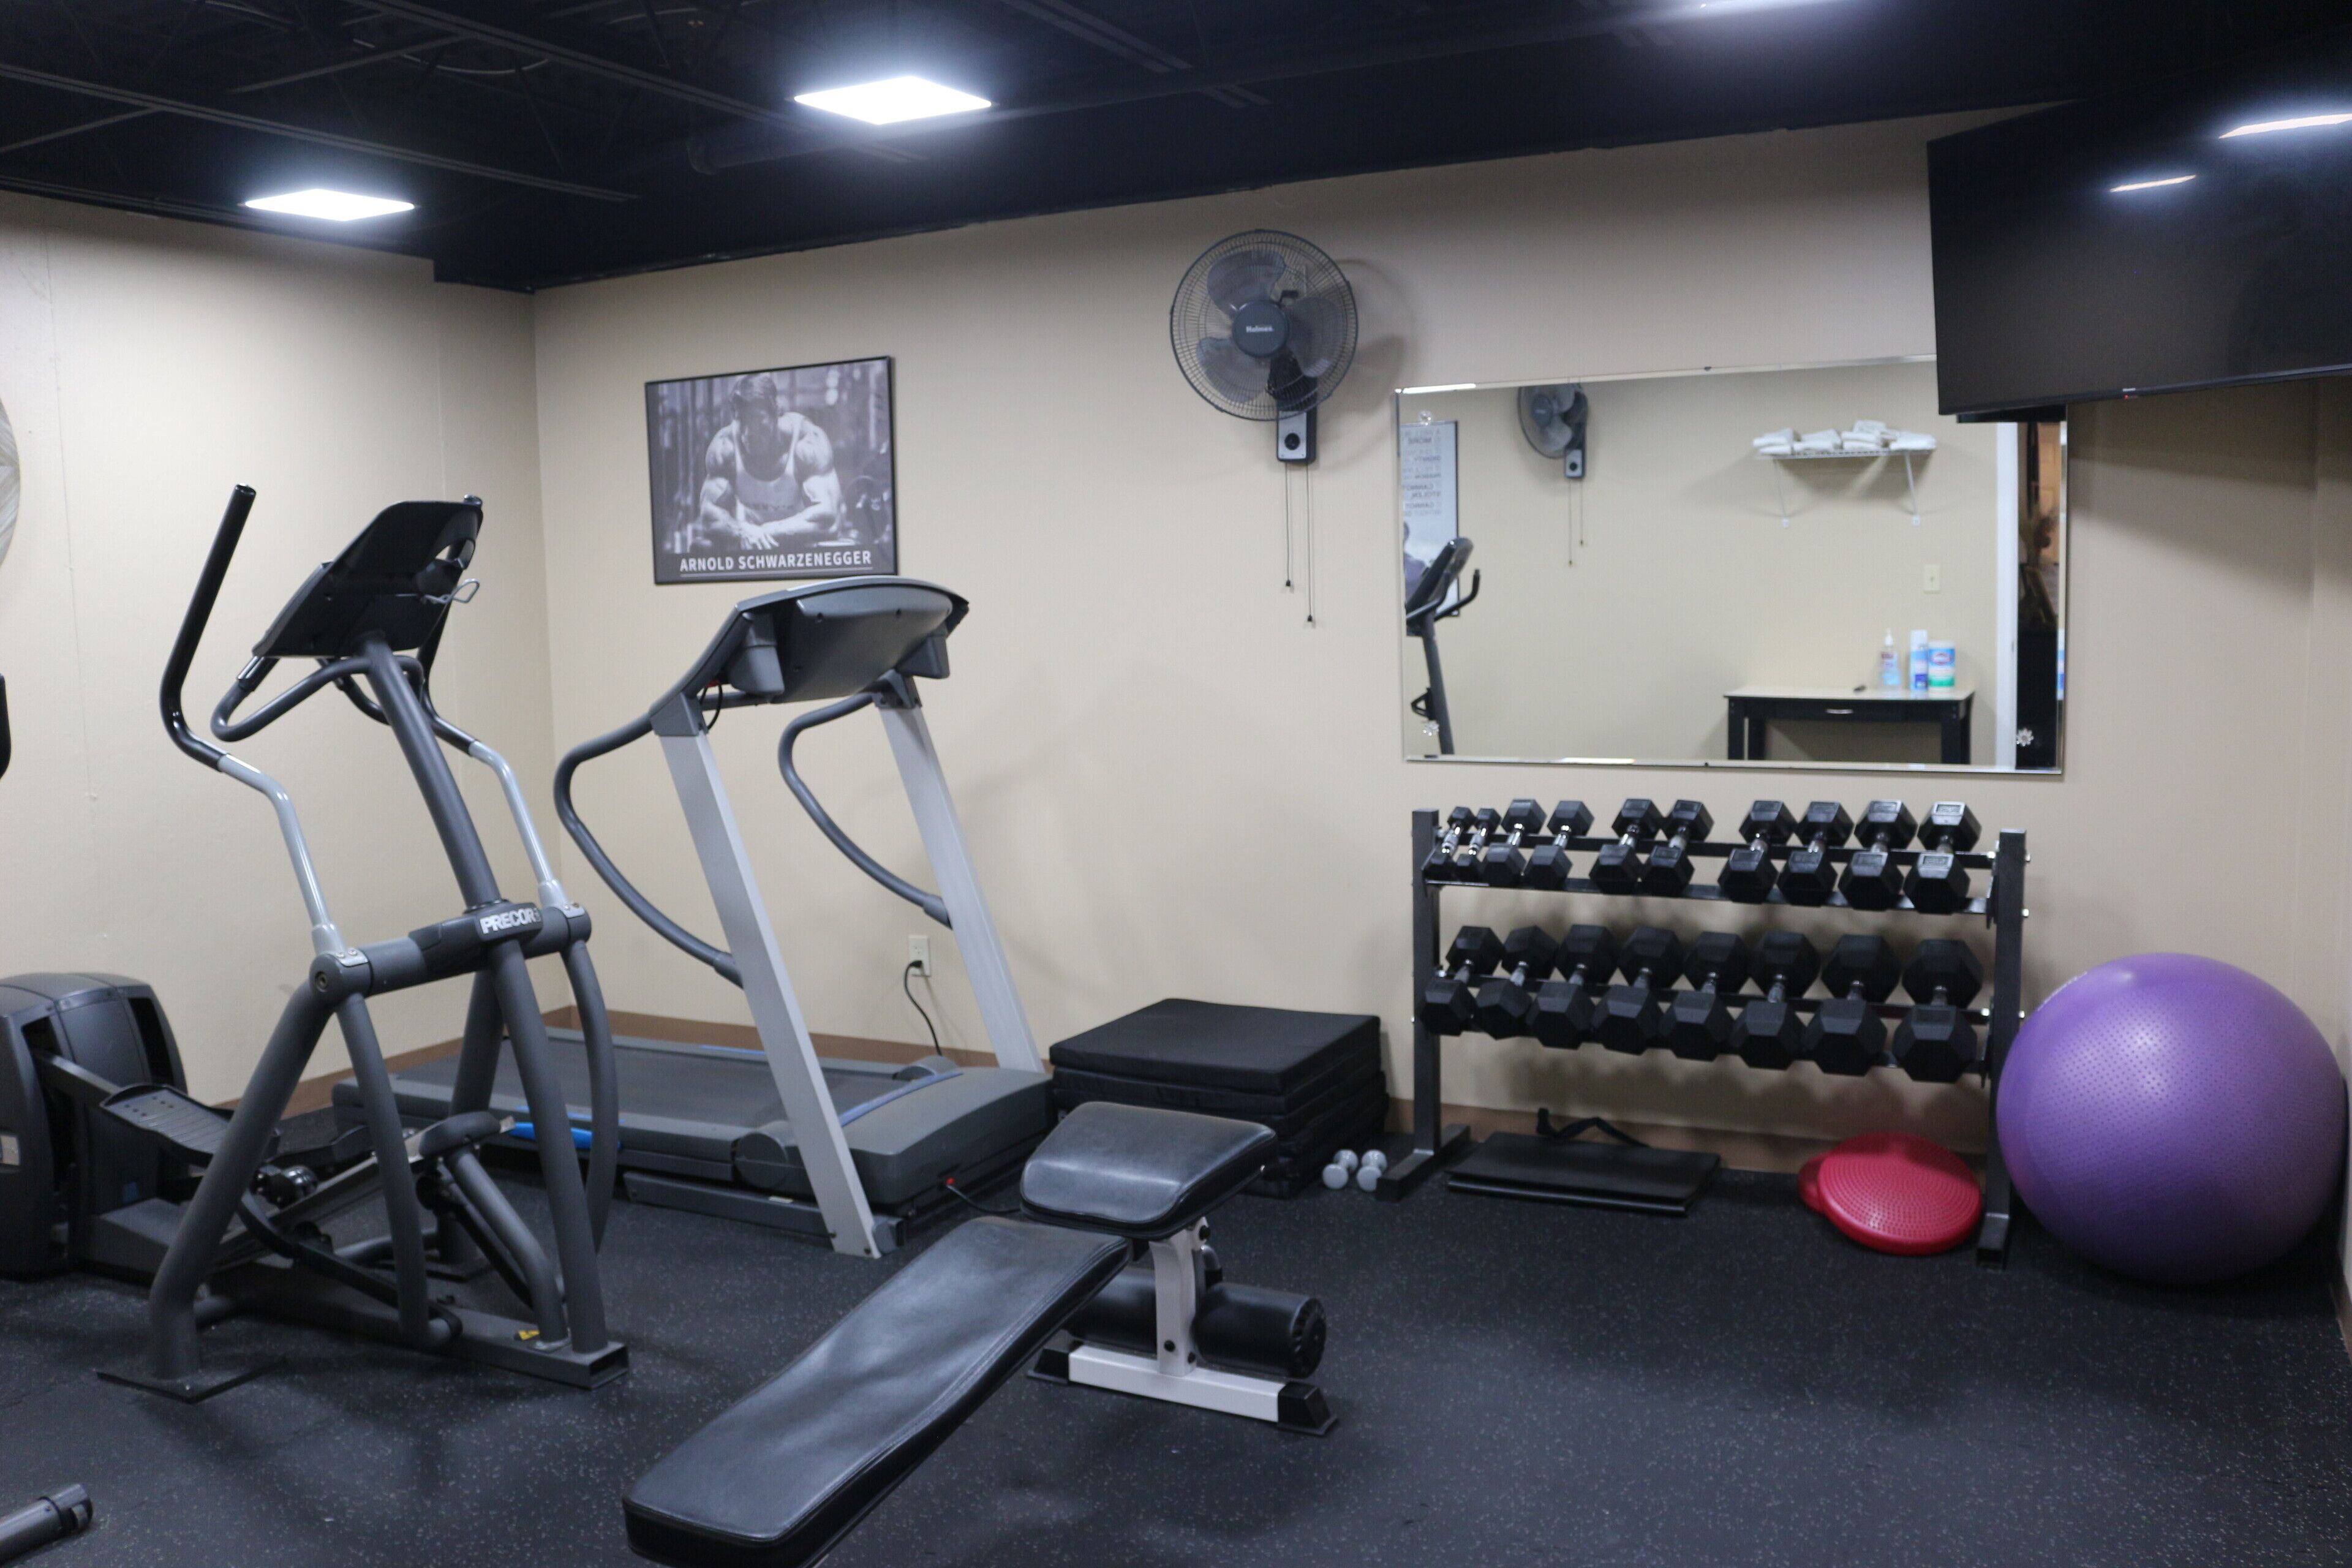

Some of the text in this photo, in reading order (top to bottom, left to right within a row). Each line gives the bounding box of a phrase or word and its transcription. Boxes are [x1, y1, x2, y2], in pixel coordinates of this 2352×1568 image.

[680, 550, 872, 571] ARNOLD SCHWARZENEGGER
[480, 908, 537, 934] PRECOR
